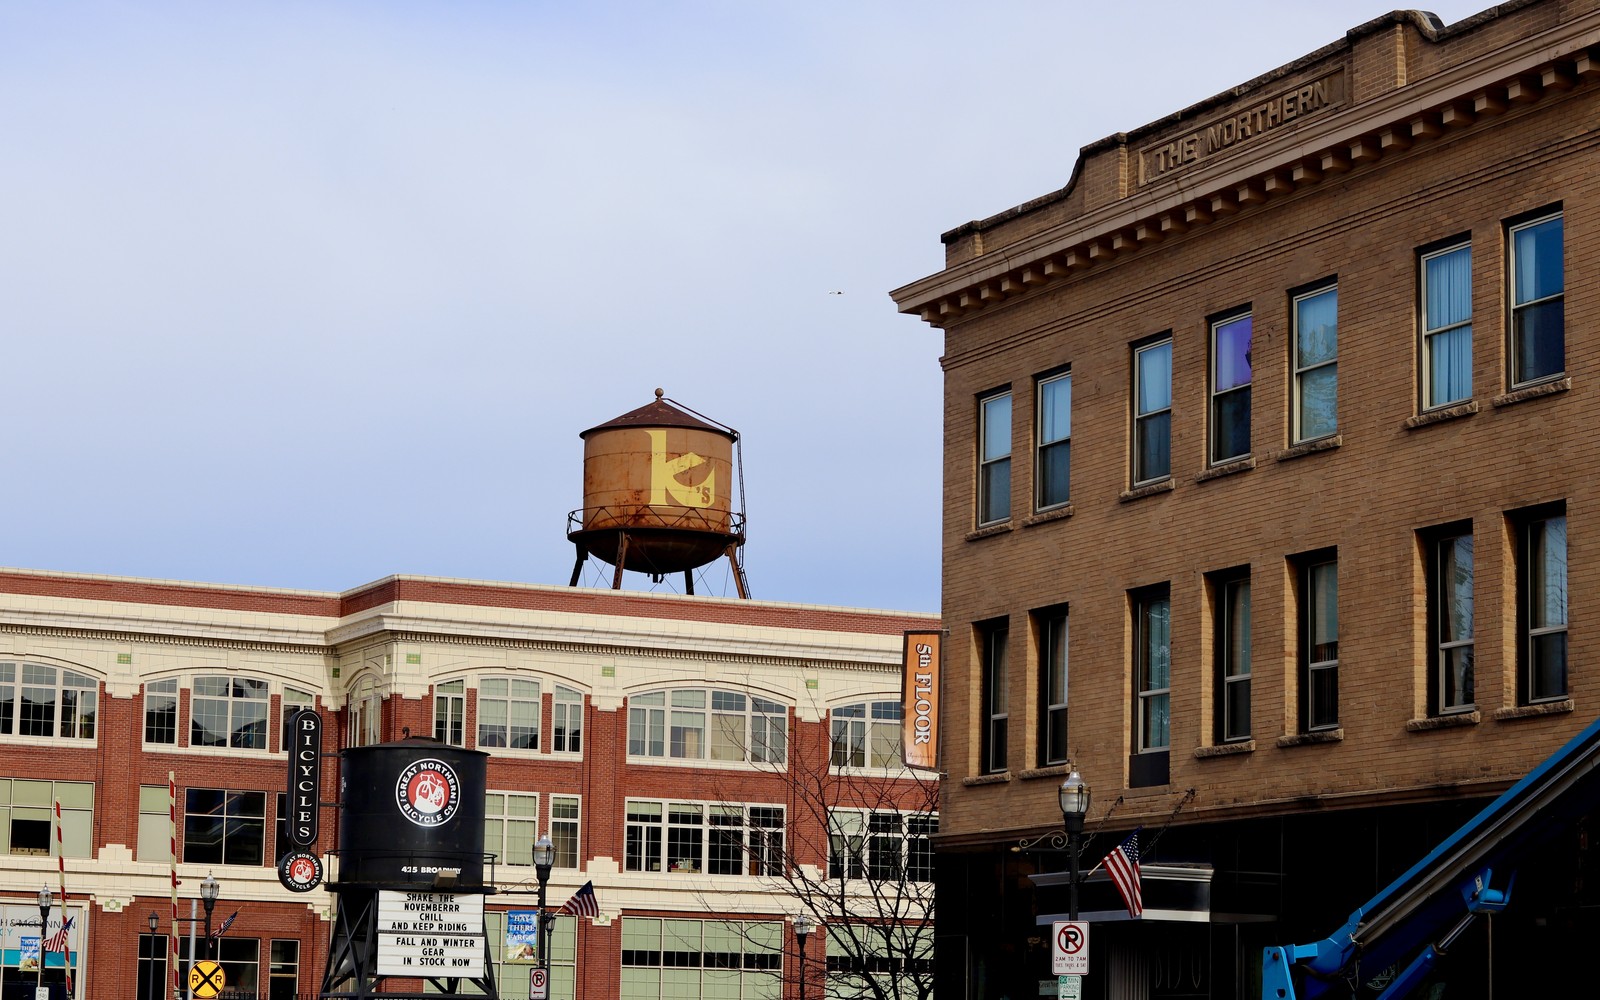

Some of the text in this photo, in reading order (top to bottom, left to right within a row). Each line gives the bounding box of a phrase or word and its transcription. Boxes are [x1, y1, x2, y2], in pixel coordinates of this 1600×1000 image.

[1155, 79, 1329, 172] THE NORTHERN
[916, 643, 932, 668] 5th
[914, 672, 932, 745] FLOOR
[298, 719, 316, 838] BICYCLES
[399, 762, 457, 800] GREAT NORTHERN
[402, 803, 443, 823] BICYCLE
[285, 853, 320, 876] GREAT NORTHERN
[401, 865, 418, 874] 425
[287, 877, 310, 890] BICYCLE
[406, 893, 455, 903] SHAKE THE
[404, 902, 460, 912] NOVEMBERRR
[419, 912, 444, 922] CHILL
[391, 921, 467, 932] AND KEEP RIDING
[396, 937, 475, 948] FALL AND WINTER
[422, 948, 444, 957] GEAR
[403, 957, 471, 967] IN STOCK NOW
[192, 974, 223, 984] R R
